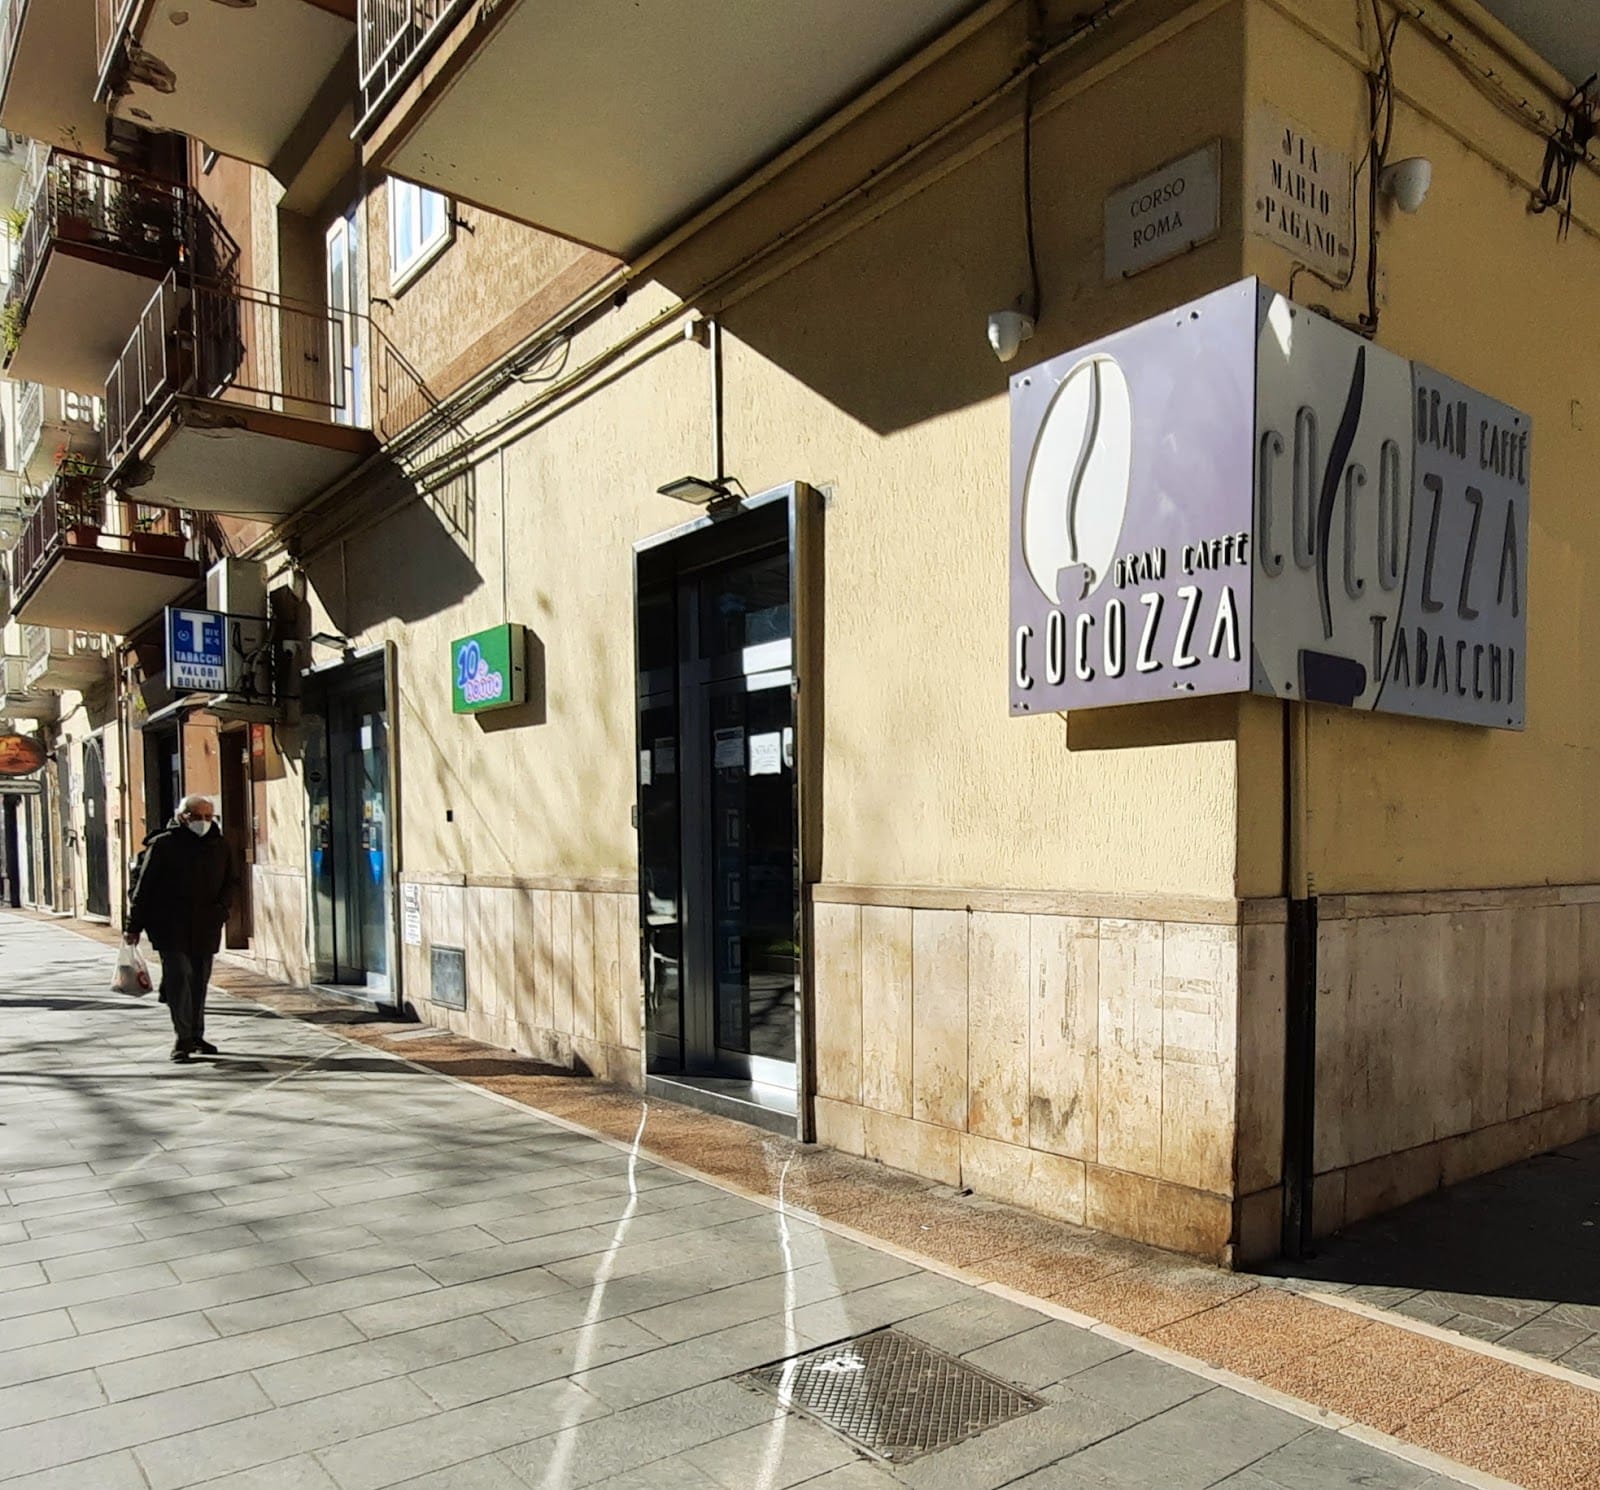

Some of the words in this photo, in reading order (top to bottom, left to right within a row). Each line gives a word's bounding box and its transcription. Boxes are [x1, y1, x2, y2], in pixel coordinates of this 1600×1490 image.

[1284, 128, 1318, 174] VIA
[1129, 177, 1187, 218] CORSO
[1272, 158, 1330, 216] MARIO
[1132, 210, 1184, 249] ROMA
[1265, 195, 1336, 258] PAGANO
[1416, 386, 1469, 460] GRAN
[1258, 404, 1520, 622] COCOZZA
[1113, 546, 1166, 590] GRAN
[180, 611, 216, 653] T
[1016, 584, 1241, 690] COCOZZA
[176, 651, 222, 665] TABACCHI
[180, 665, 218, 678] VALORI
[458, 641, 480, 688] 10
[1369, 614, 1516, 705] TABACCHI
[177, 677, 221, 689] BOLLATI
